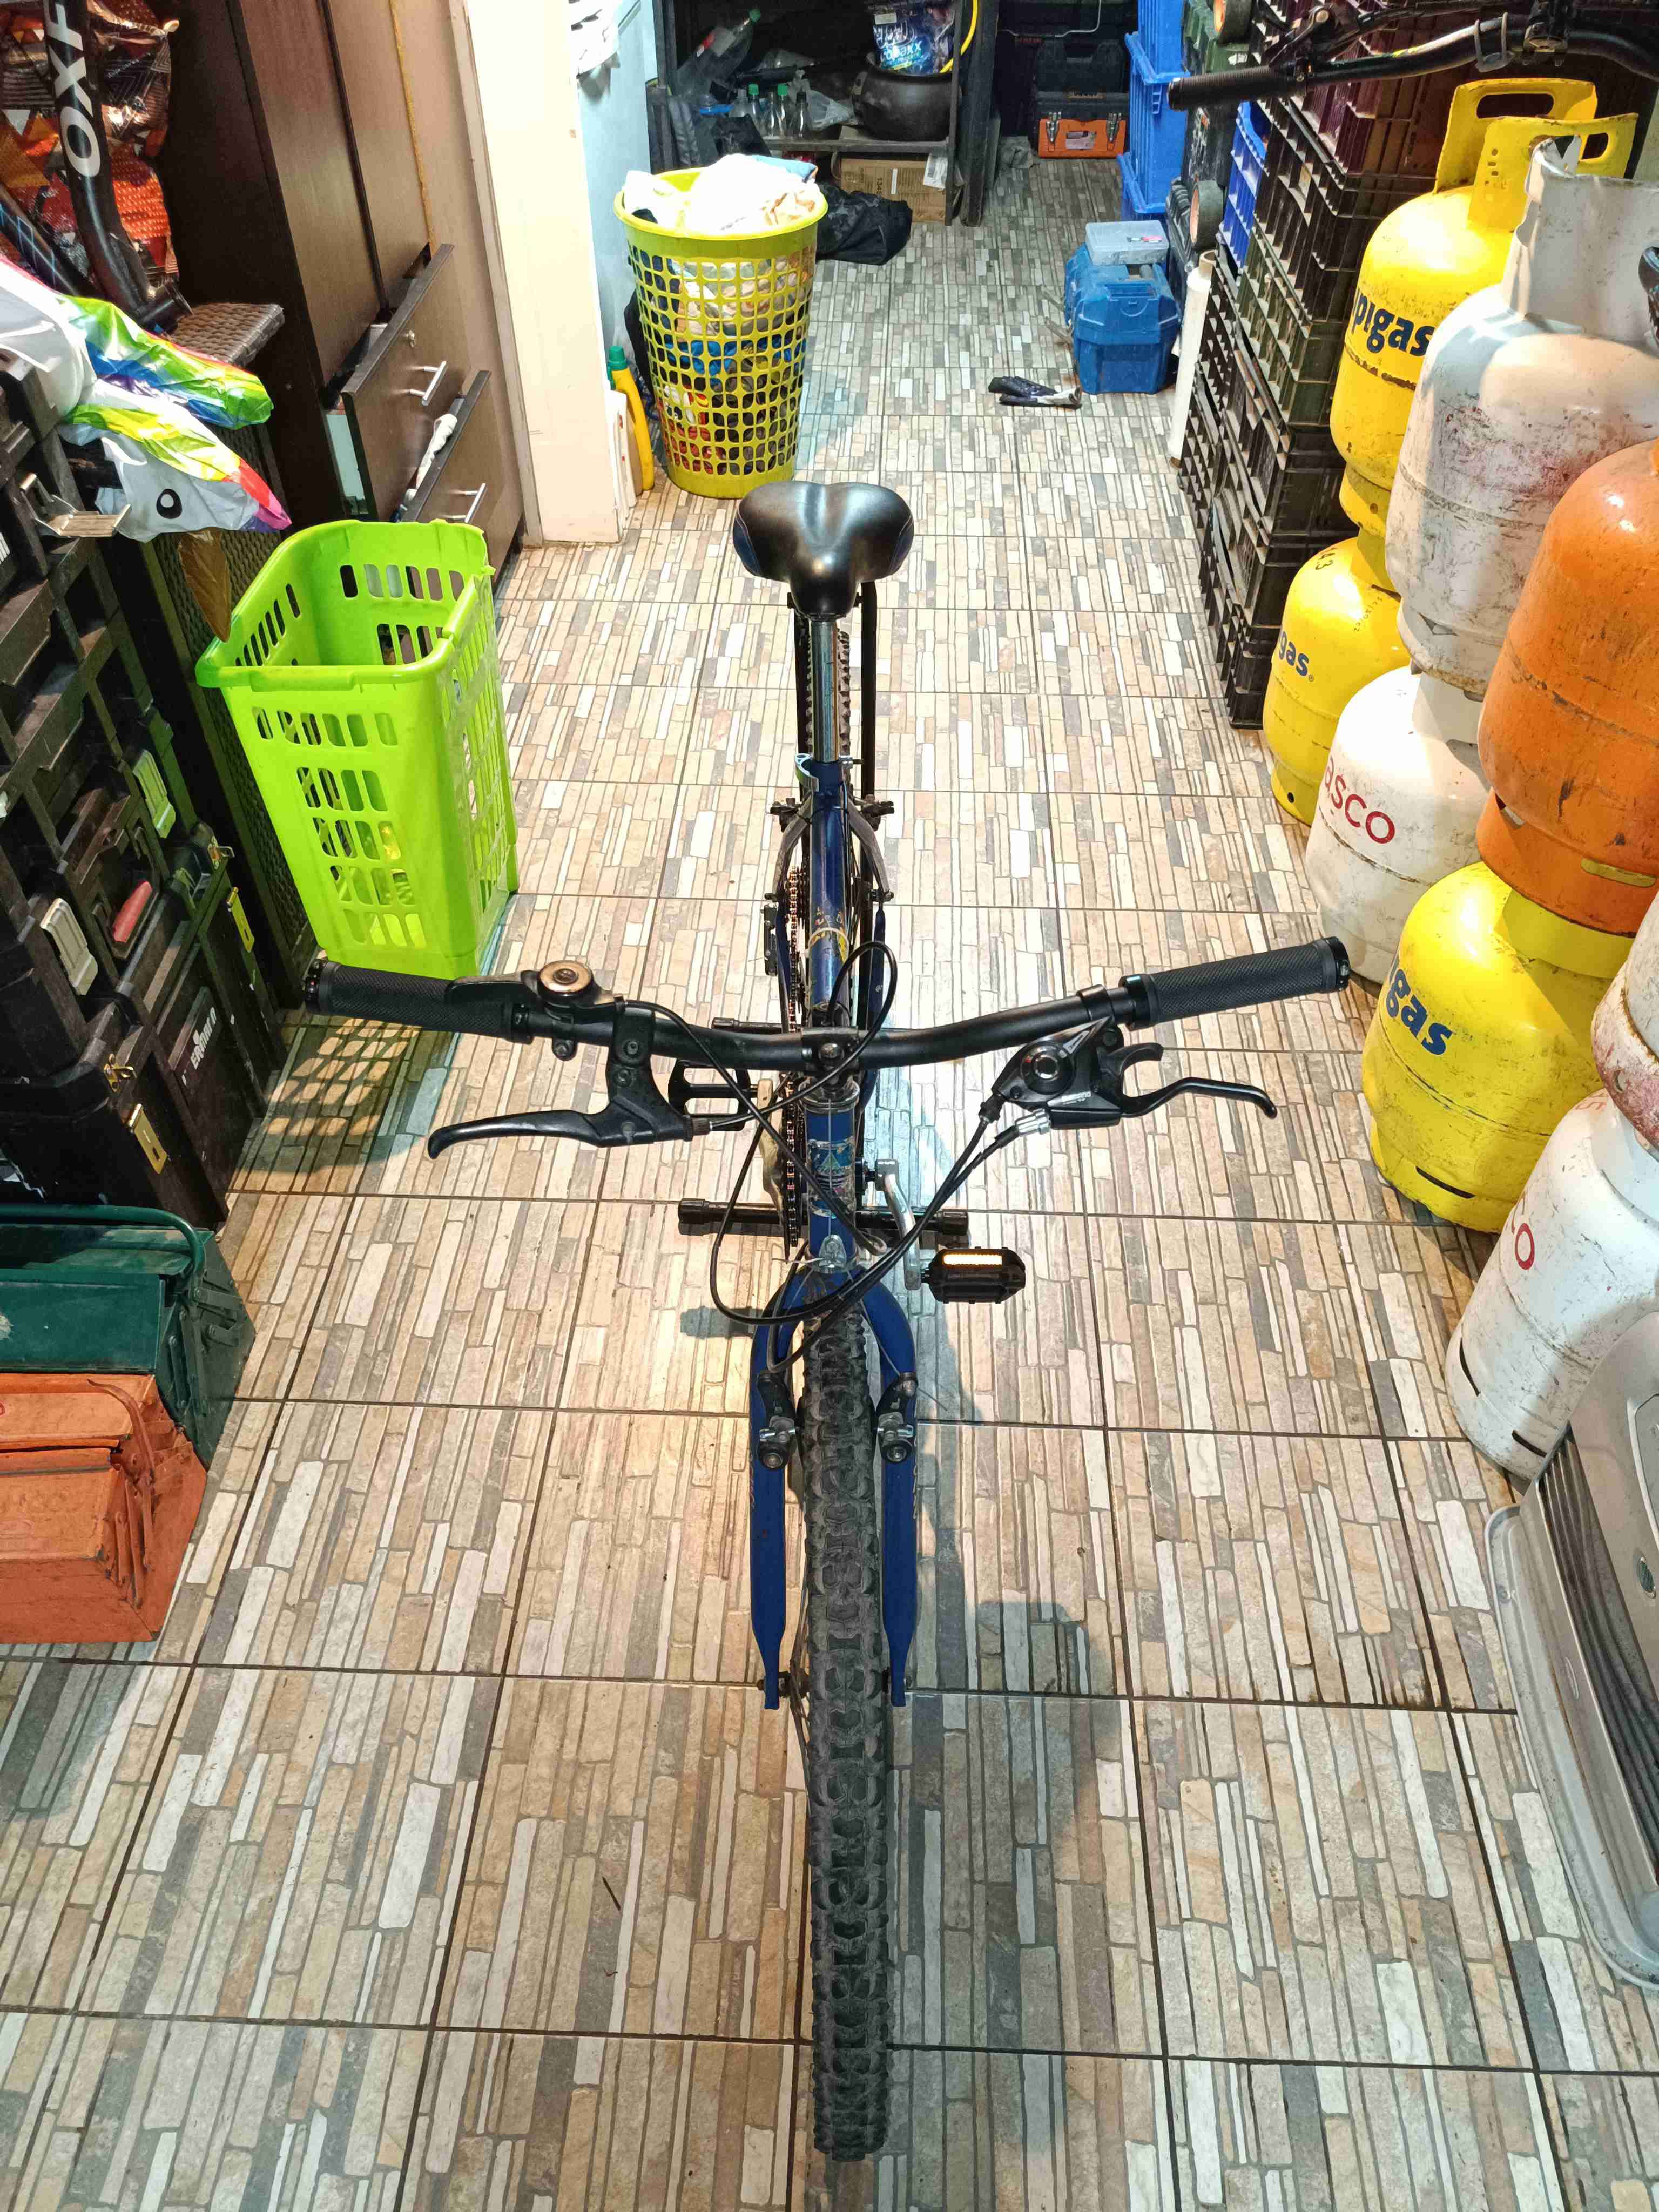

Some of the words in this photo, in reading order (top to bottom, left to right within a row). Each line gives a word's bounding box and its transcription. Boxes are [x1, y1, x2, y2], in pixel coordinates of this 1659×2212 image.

[1352, 287, 1436, 357] pigas
[1278, 630, 1310, 676] gas
[1386, 958, 1453, 1055] gas
